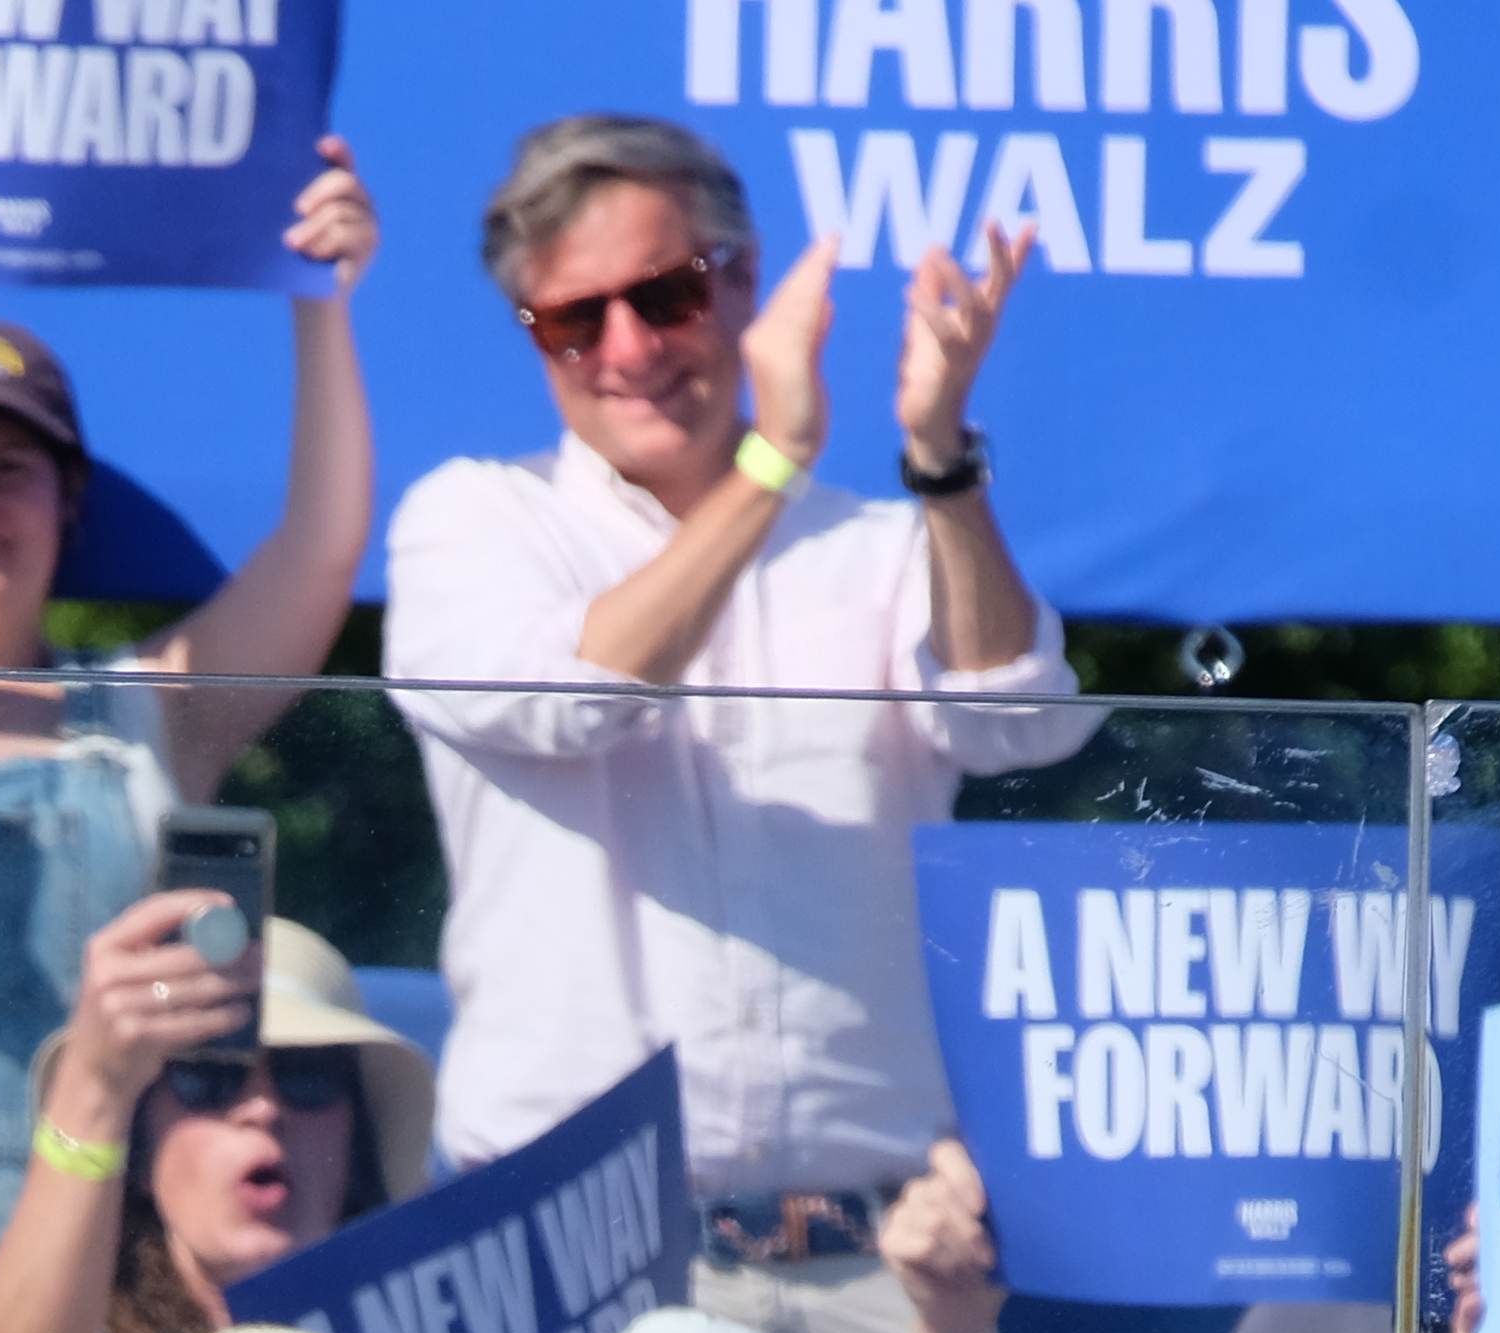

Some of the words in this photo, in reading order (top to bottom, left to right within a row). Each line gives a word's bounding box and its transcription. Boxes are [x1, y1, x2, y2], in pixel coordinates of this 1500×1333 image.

[791, 129, 1308, 278] WALZ
[982, 889, 1056, 1019] A
[1078, 889, 1308, 1021] NEW
[534, 1124, 662, 1288] WAY
